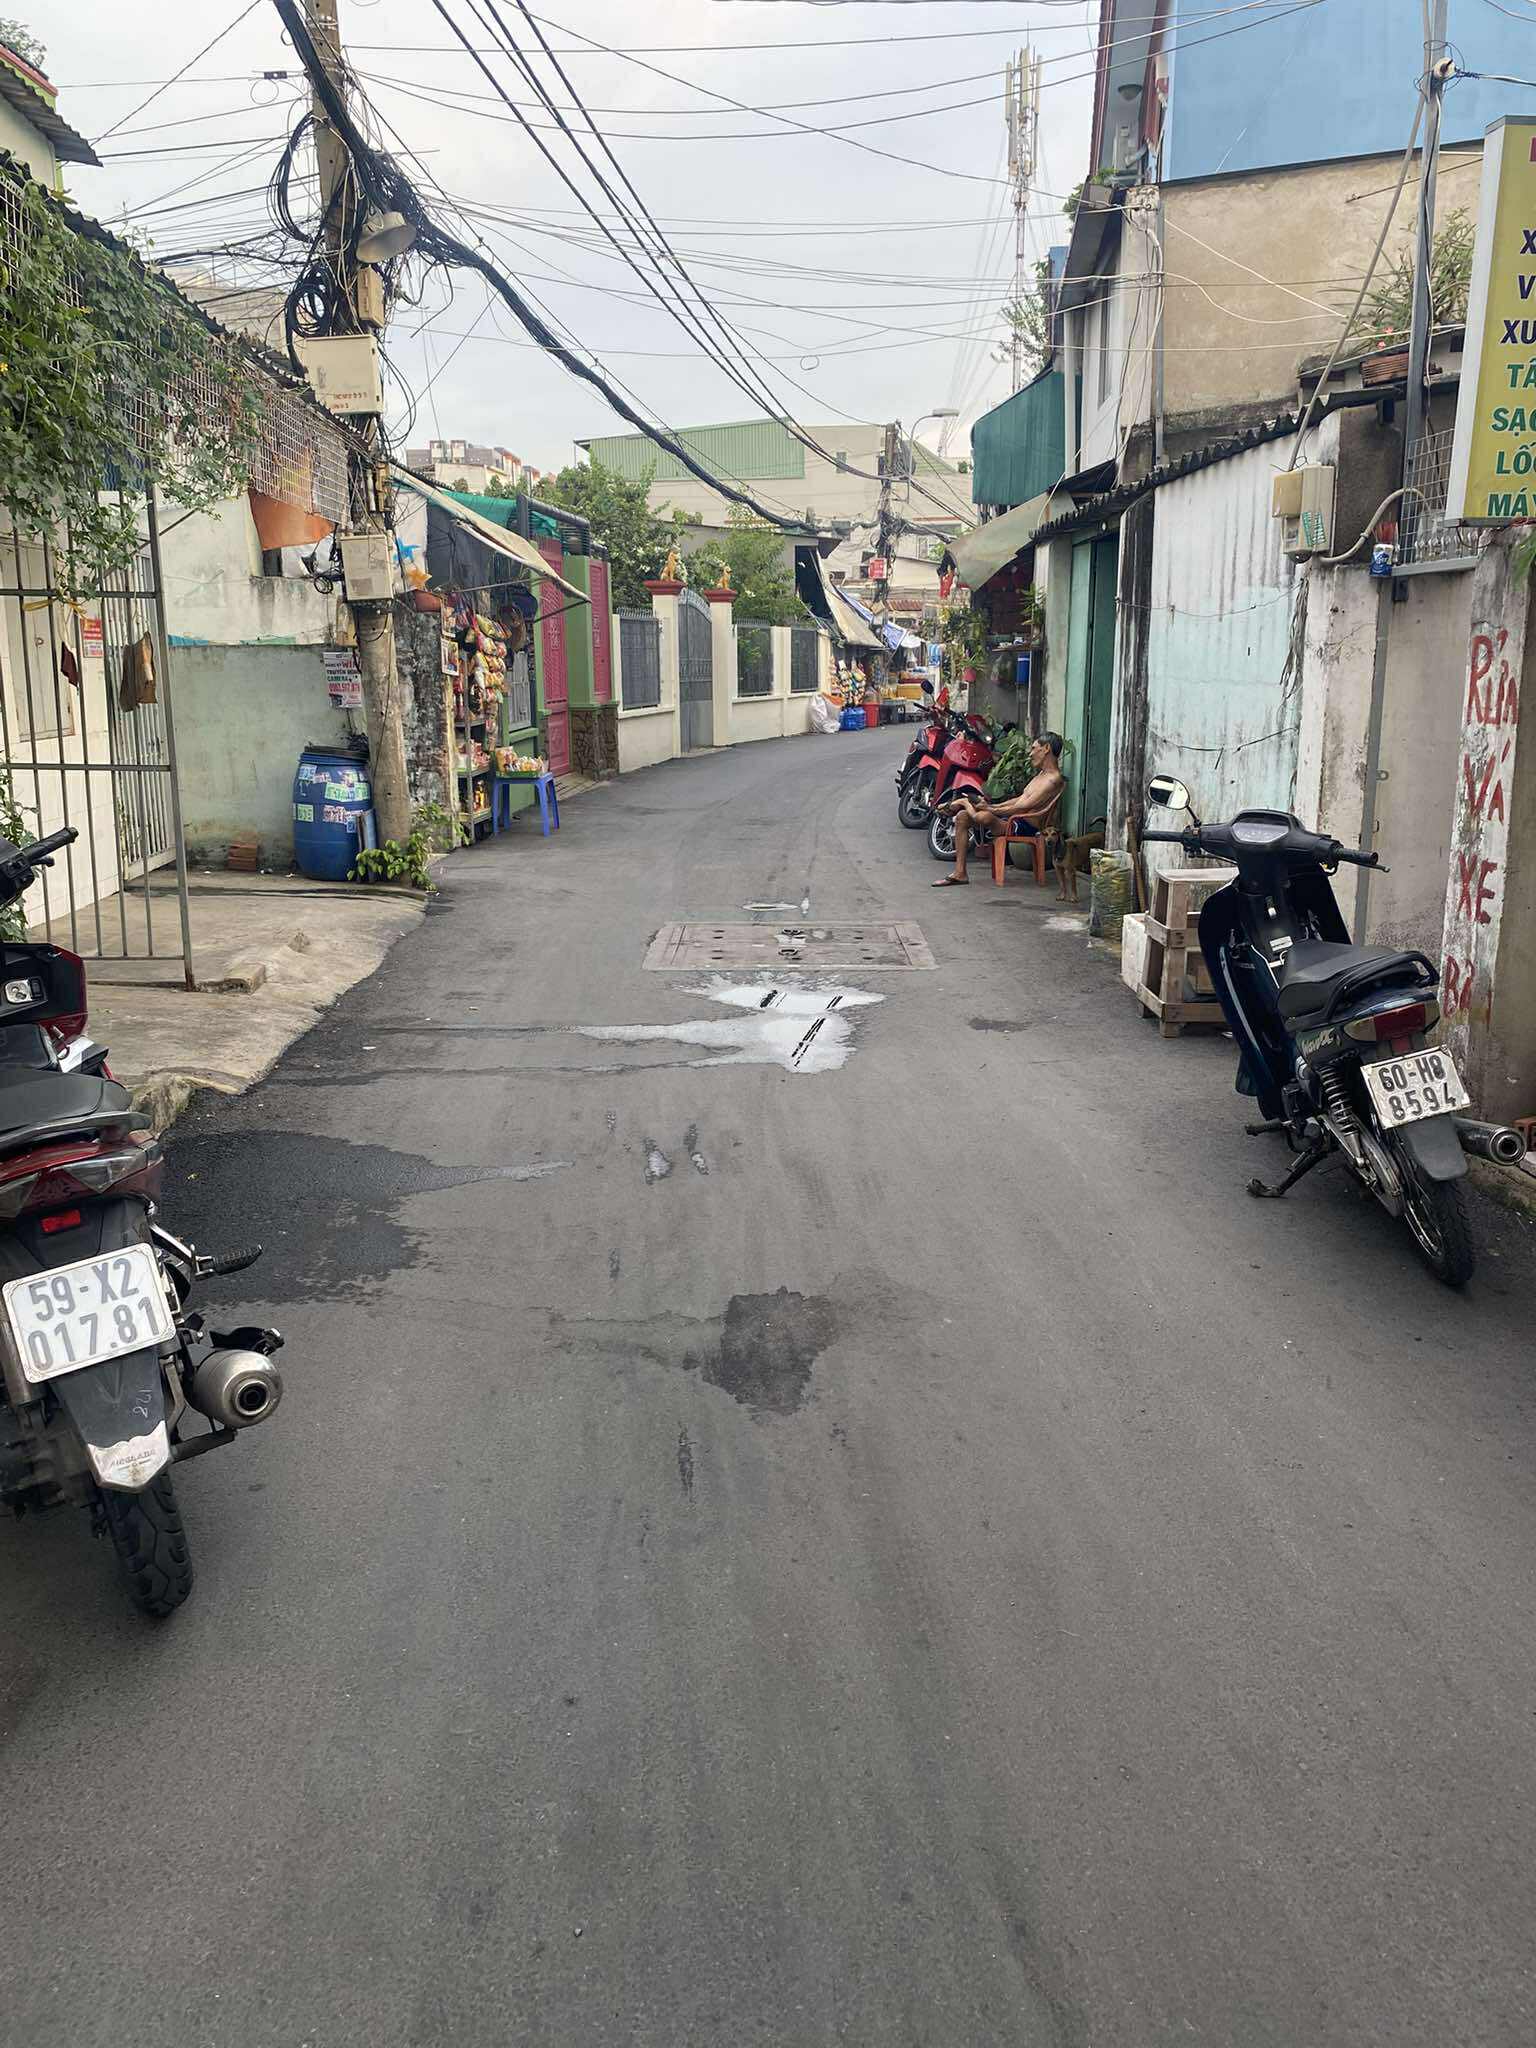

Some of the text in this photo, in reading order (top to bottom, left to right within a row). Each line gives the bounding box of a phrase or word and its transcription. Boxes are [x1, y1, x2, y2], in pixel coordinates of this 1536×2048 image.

[1496, 441, 1536, 475] LỐ
[1487, 487, 1536, 517] MÁ
[1457, 850, 1498, 926] XE
[1378, 1055, 1447, 1093] 60-H8
[1388, 1082, 1457, 1121] 8594
[28, 1257, 140, 1322] 59-X2
[27, 1296, 160, 1372] 017.81
